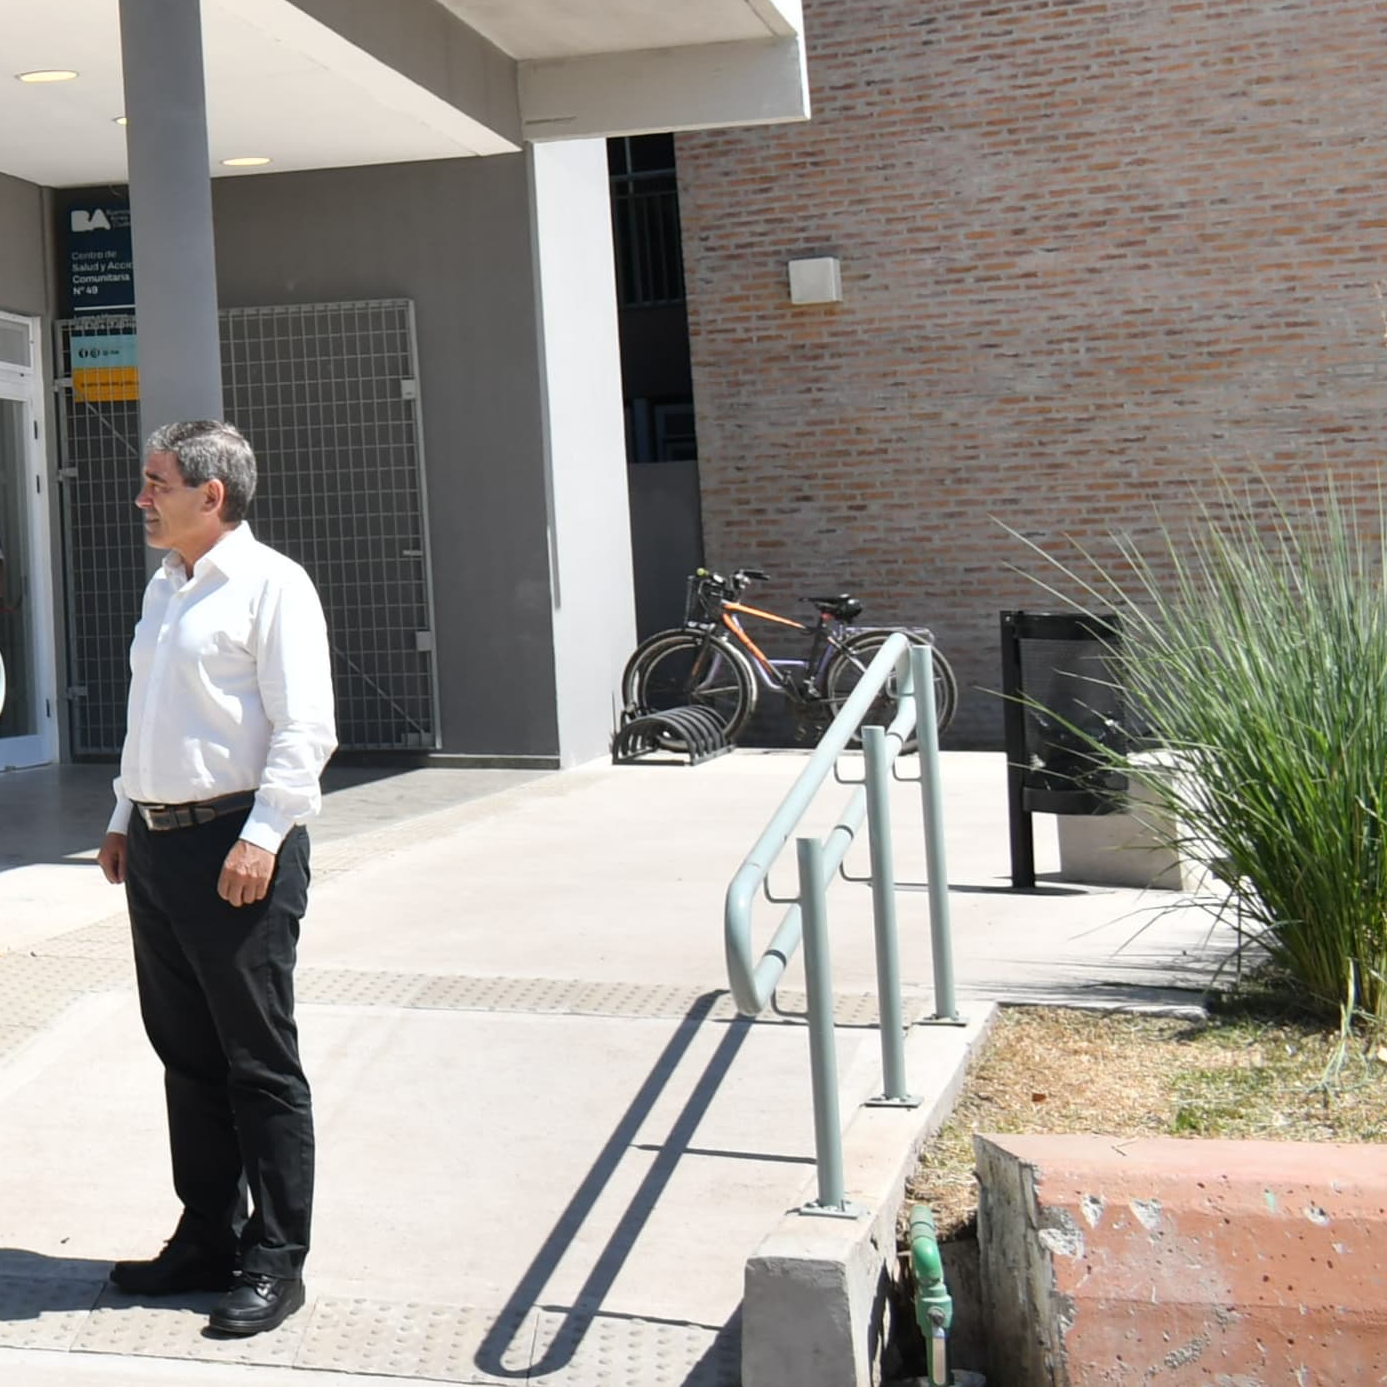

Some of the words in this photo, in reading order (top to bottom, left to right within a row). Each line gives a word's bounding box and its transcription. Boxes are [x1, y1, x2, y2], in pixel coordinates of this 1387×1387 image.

[71, 251, 104, 260] Centro
[104, 250, 117, 259] de
[72, 261, 99, 272] Salud
[100, 263, 107, 273] y
[72, 273, 131, 284] Comunitaria
